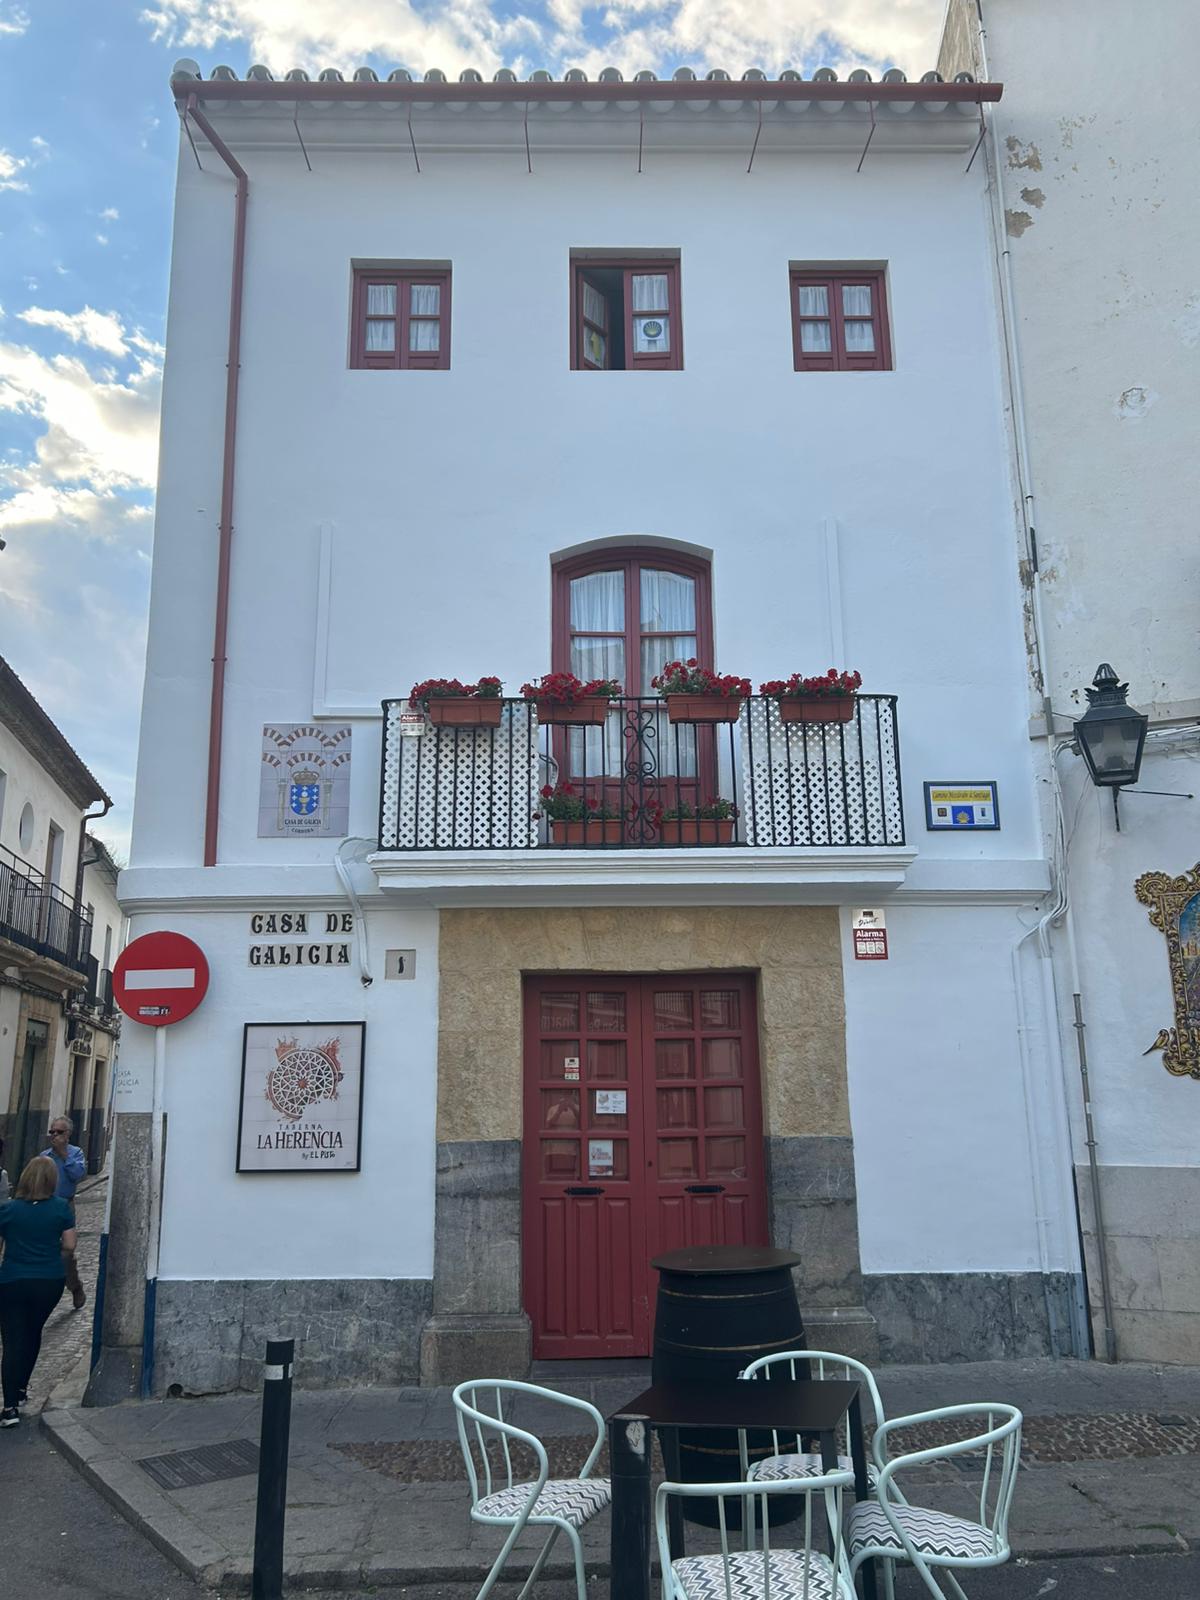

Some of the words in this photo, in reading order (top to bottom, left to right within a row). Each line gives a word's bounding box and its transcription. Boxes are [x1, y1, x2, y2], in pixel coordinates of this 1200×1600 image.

[251, 913, 307, 934] CASA
[326, 913, 353, 933] DE
[856, 930, 884, 938] Alarma
[249, 944, 350, 966] GALICIA
[257, 1134, 273, 1149] LA
